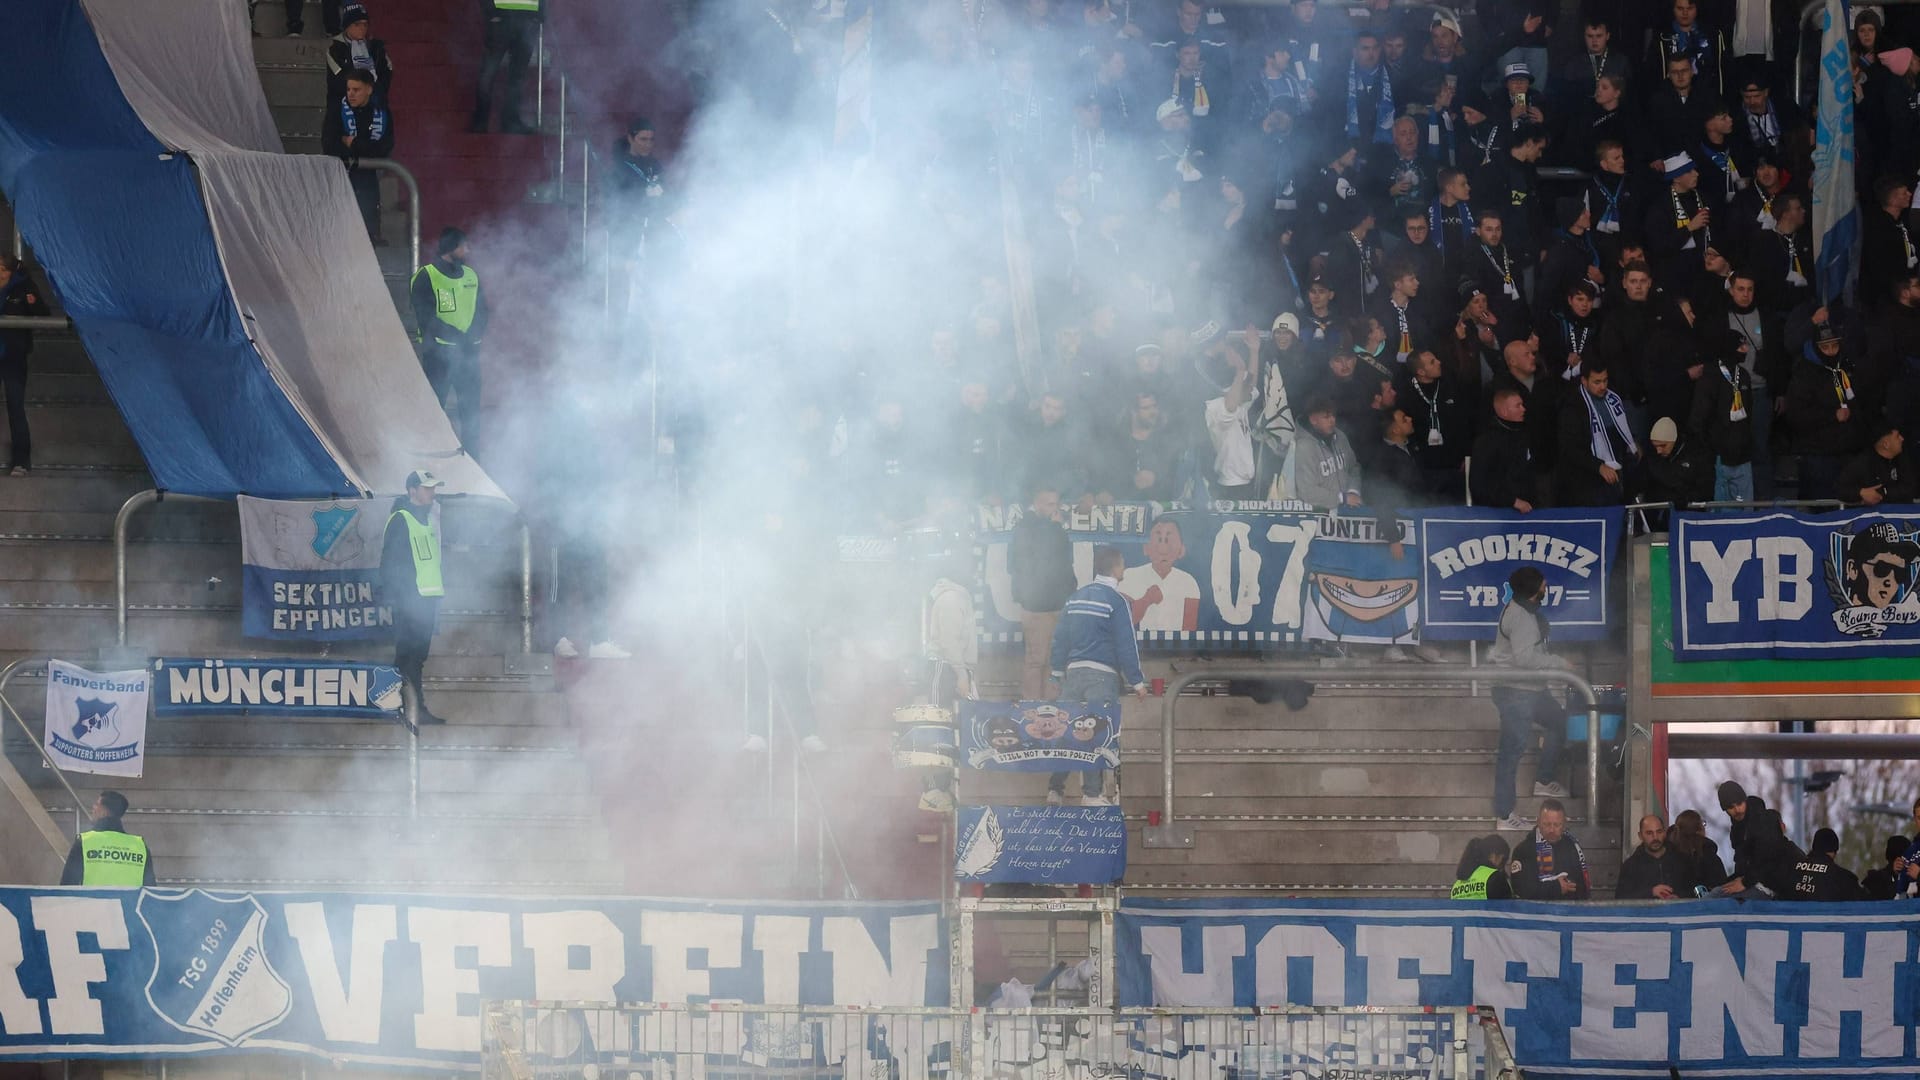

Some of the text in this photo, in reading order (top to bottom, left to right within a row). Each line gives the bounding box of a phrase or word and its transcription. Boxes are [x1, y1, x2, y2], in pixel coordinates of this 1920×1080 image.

[1320, 516, 1406, 541] UNITD
[1429, 534, 1599, 580] ROOKIEZ
[1690, 535, 1814, 624] YB
[273, 581, 373, 606] SEKTION
[1466, 585, 1499, 607] YB
[272, 606, 394, 631] EPPINGEN
[1839, 608, 1878, 627] Young
[52, 670, 145, 693] Fanverband
[169, 659, 368, 706] MÜNCHEN
[55, 739, 135, 761] SUPPORTERS HOFFENHEIM
[998, 751, 1021, 762] STILL
[1024, 750, 1039, 759] NOT
[1069, 750, 1096, 762] POLICE
[1069, 824, 1089, 837] Das
[1008, 856, 1039, 871] Herzen
[1795, 862, 1829, 873] POLIZEI
[1795, 882, 1816, 893] 6421
[1802, 874, 1814, 884] BY
[178, 918, 229, 991] TSG 1899
[284, 901, 938, 1053] VEREIN
[1141, 924, 1920, 1060] HOFFENH
